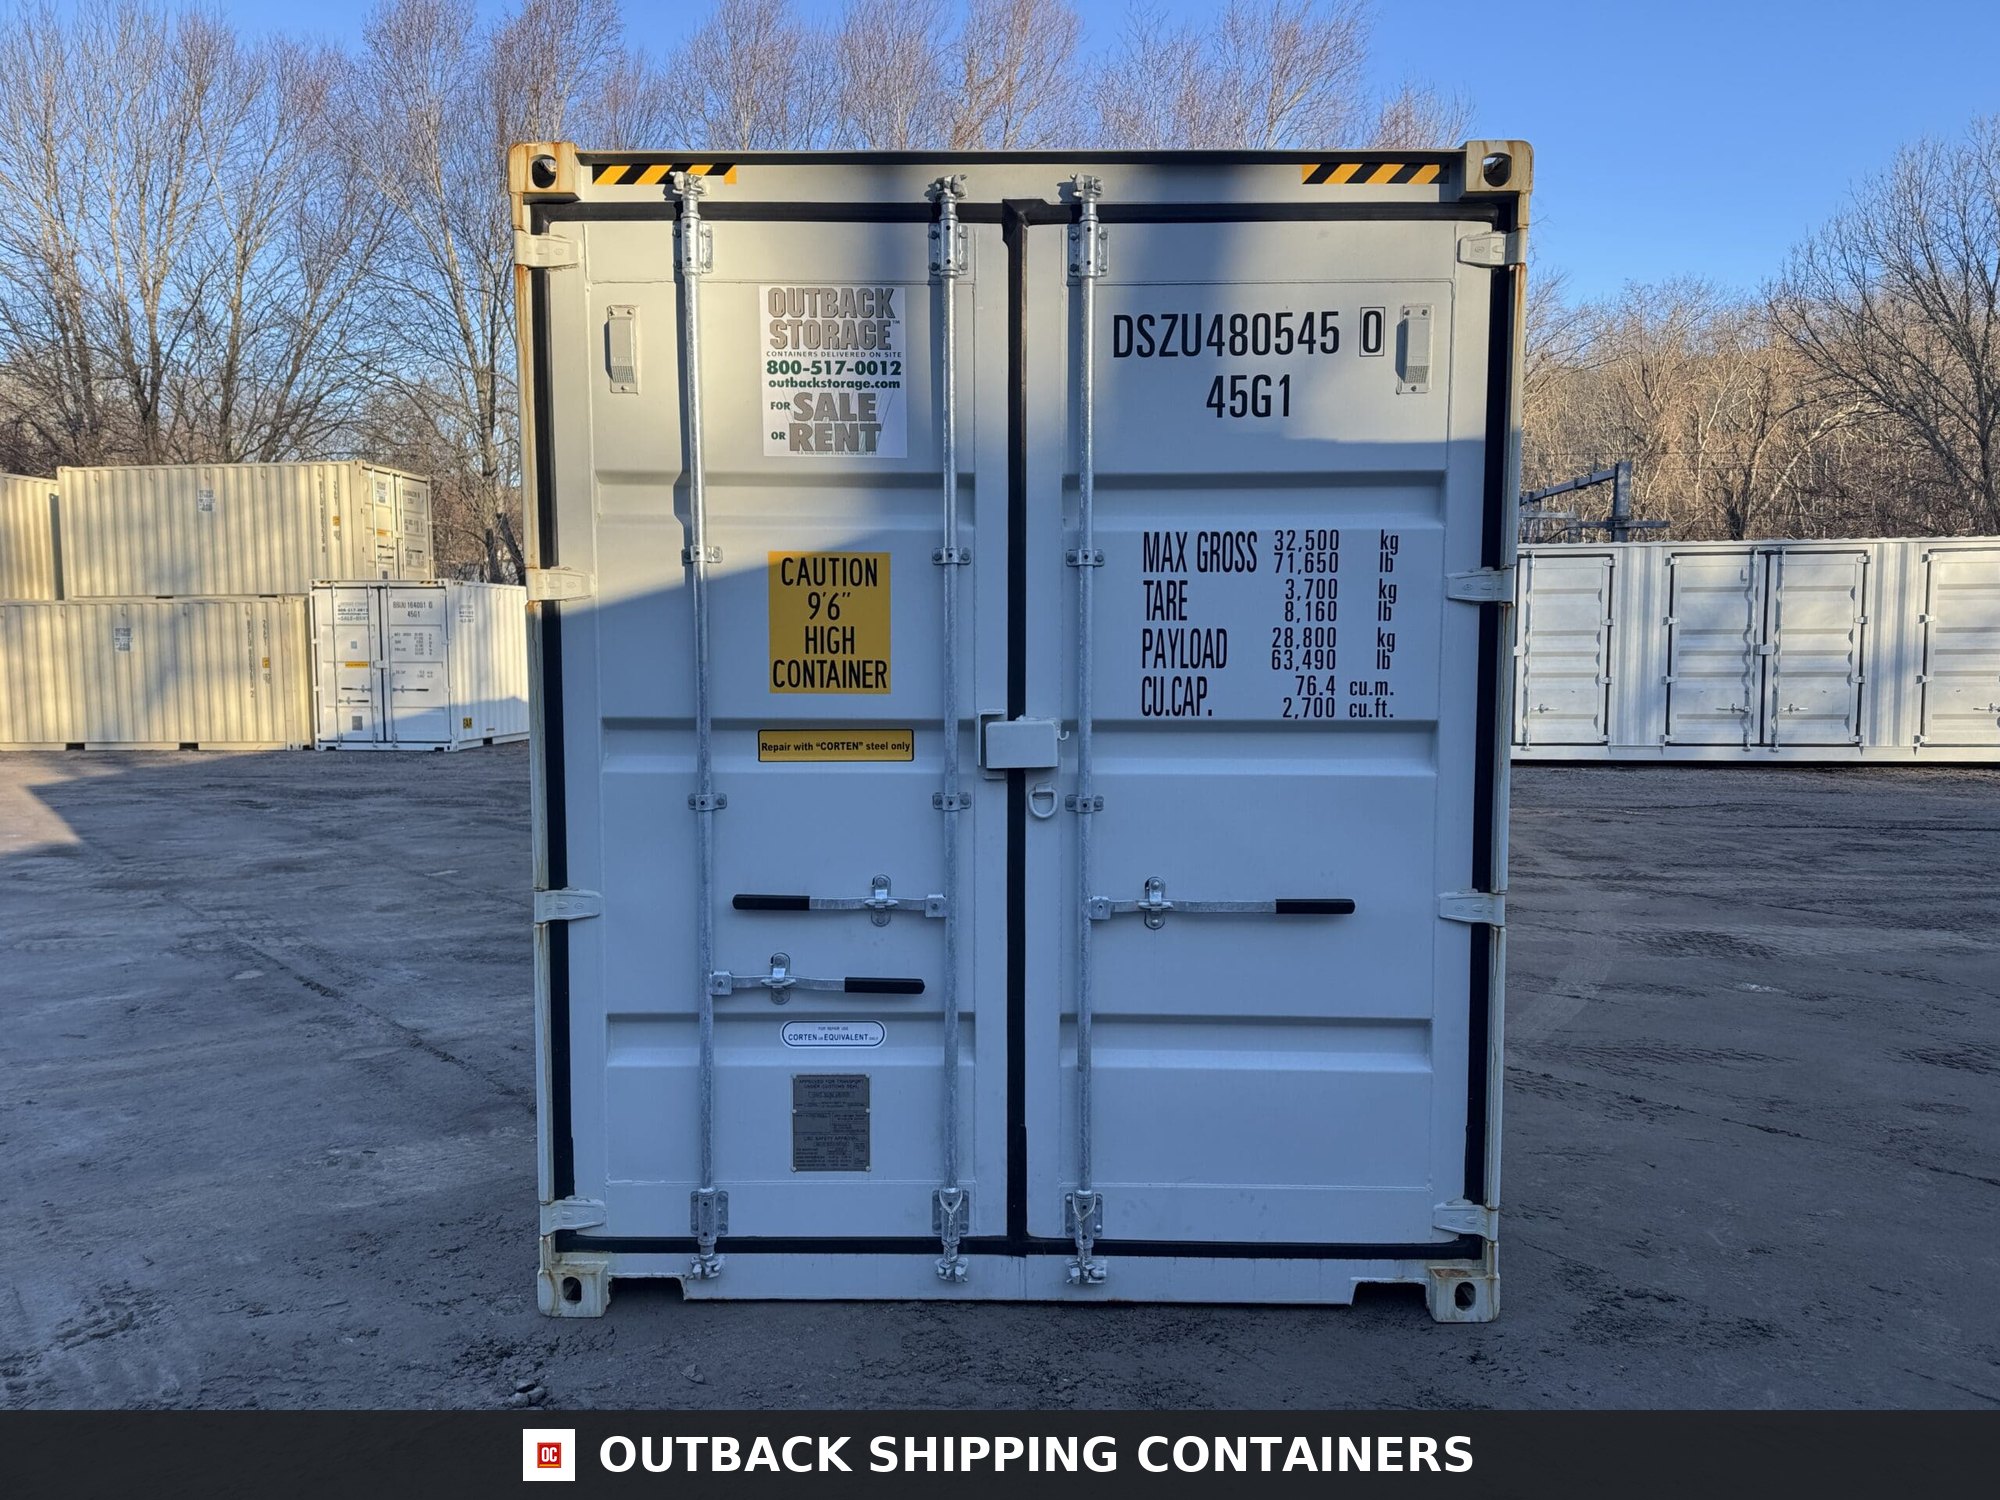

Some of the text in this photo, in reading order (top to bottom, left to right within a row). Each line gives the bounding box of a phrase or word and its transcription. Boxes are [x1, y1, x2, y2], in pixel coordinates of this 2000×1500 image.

[768, 287, 896, 318] OUTBACK
[769, 320, 892, 350] STORAGE
[1113, 310, 1382, 358] DSZU480545 0
[766, 360, 902, 375] 800-517-0012
[768, 377, 900, 390] outbackstorage.com
[1206, 374, 1291, 418] 45G1
[770, 392, 877, 422] FOR SALE
[771, 423, 882, 452] OR RENT
[1143, 530, 1399, 573] MAX GROSS 32,500 kg
[1274, 552, 1394, 574] 71,650 lb
[781, 557, 878, 587] CAUTION
[1143, 578, 1398, 621] TARE 3,700 kg
[1284, 600, 1392, 624] 8,160 lb
[805, 626, 855, 655] HIGH
[1142, 626, 1396, 669] PAYLOAD 28,800 kg
[772, 660, 888, 689] CONTAINER
[1272, 649, 1391, 672] 63,490 lb
[1142, 675, 1394, 717] CU.CAP. 76.4 cu.m.
[1282, 698, 1394, 720] 2,700 cu.ft.
[761, 742, 791, 753] Repair
[794, 742, 814, 751] with
[866, 742, 888, 750] steel
[891, 742, 910, 752] only
